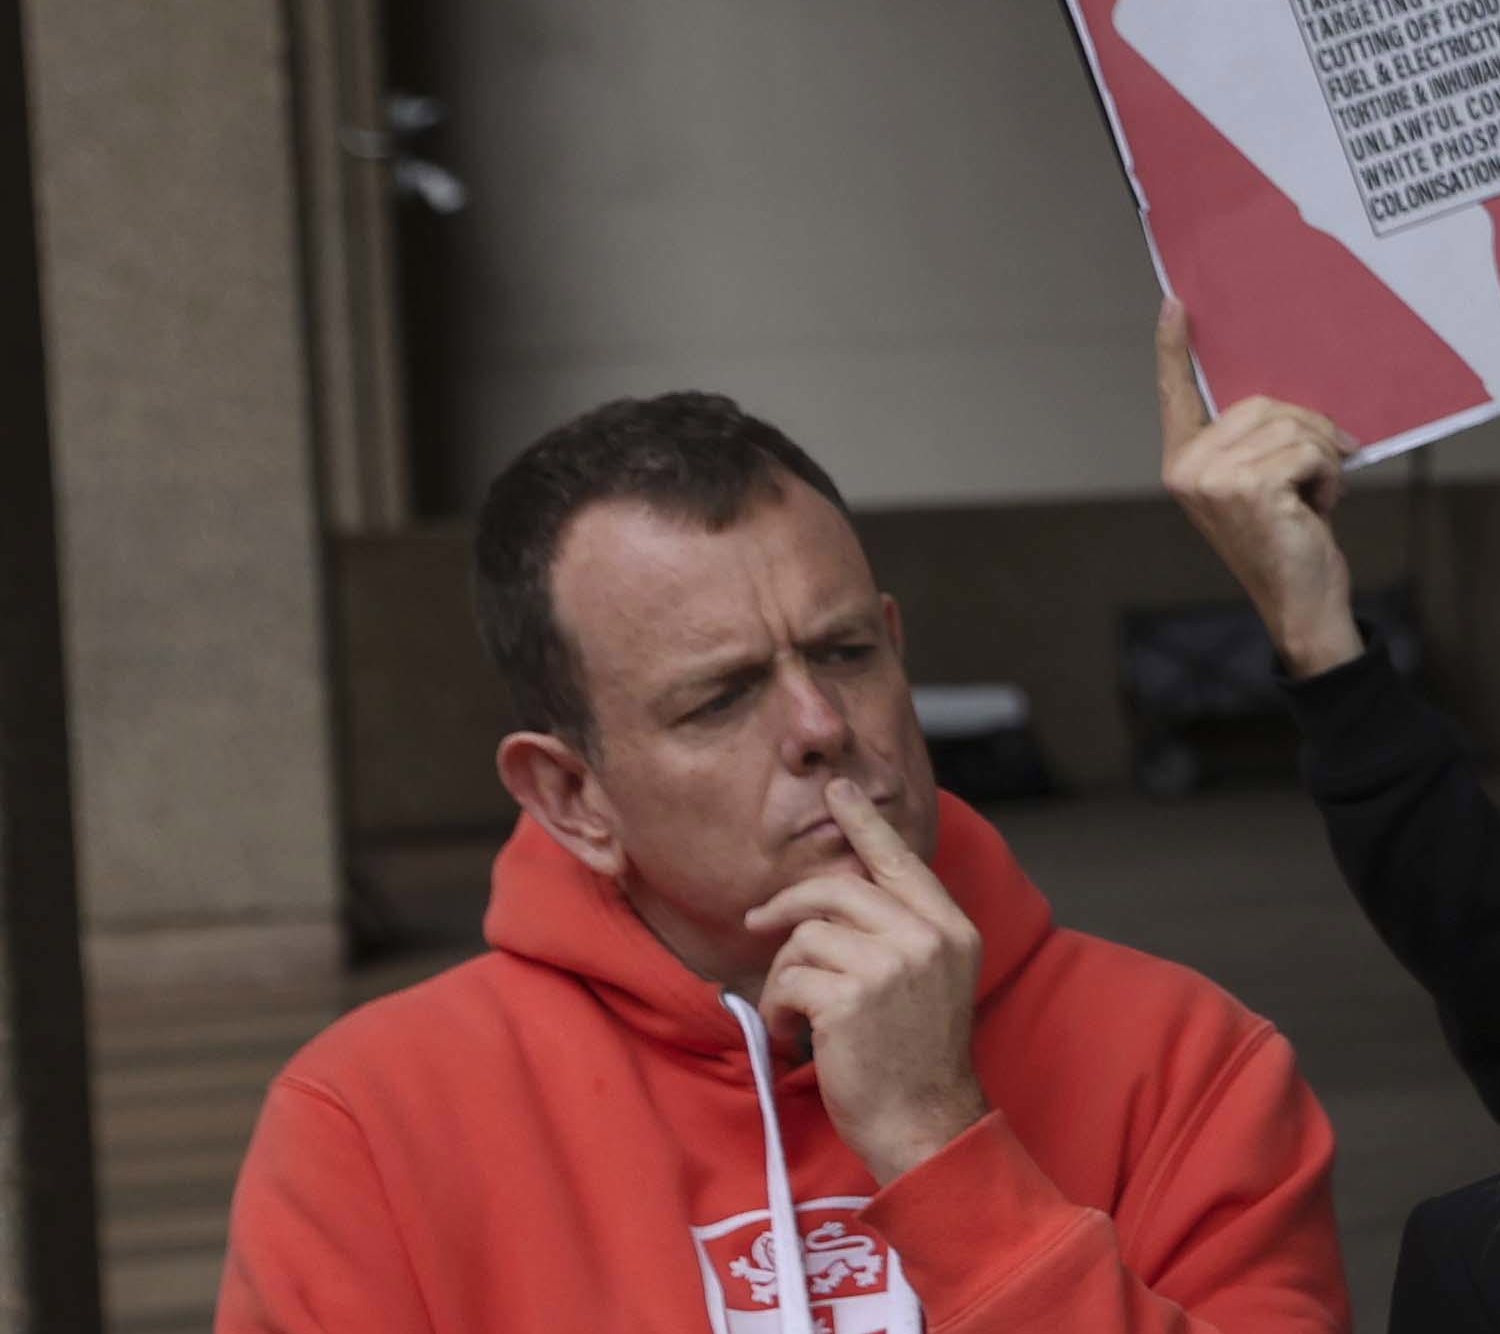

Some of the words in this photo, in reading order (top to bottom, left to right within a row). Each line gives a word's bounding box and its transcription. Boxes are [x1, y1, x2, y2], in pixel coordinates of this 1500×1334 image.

[1315, 24, 1405, 74] CUTTING
[1405, 10, 1442, 44] OFF
[1325, 68, 1376, 102] FUEL
[1374, 61, 1393, 87] &
[1335, 86, 1413, 132] TORTURE
[1412, 82, 1429, 107] &
[1348, 104, 1465, 162] UNLAWFUL
[1359, 147, 1430, 191] WHITE
